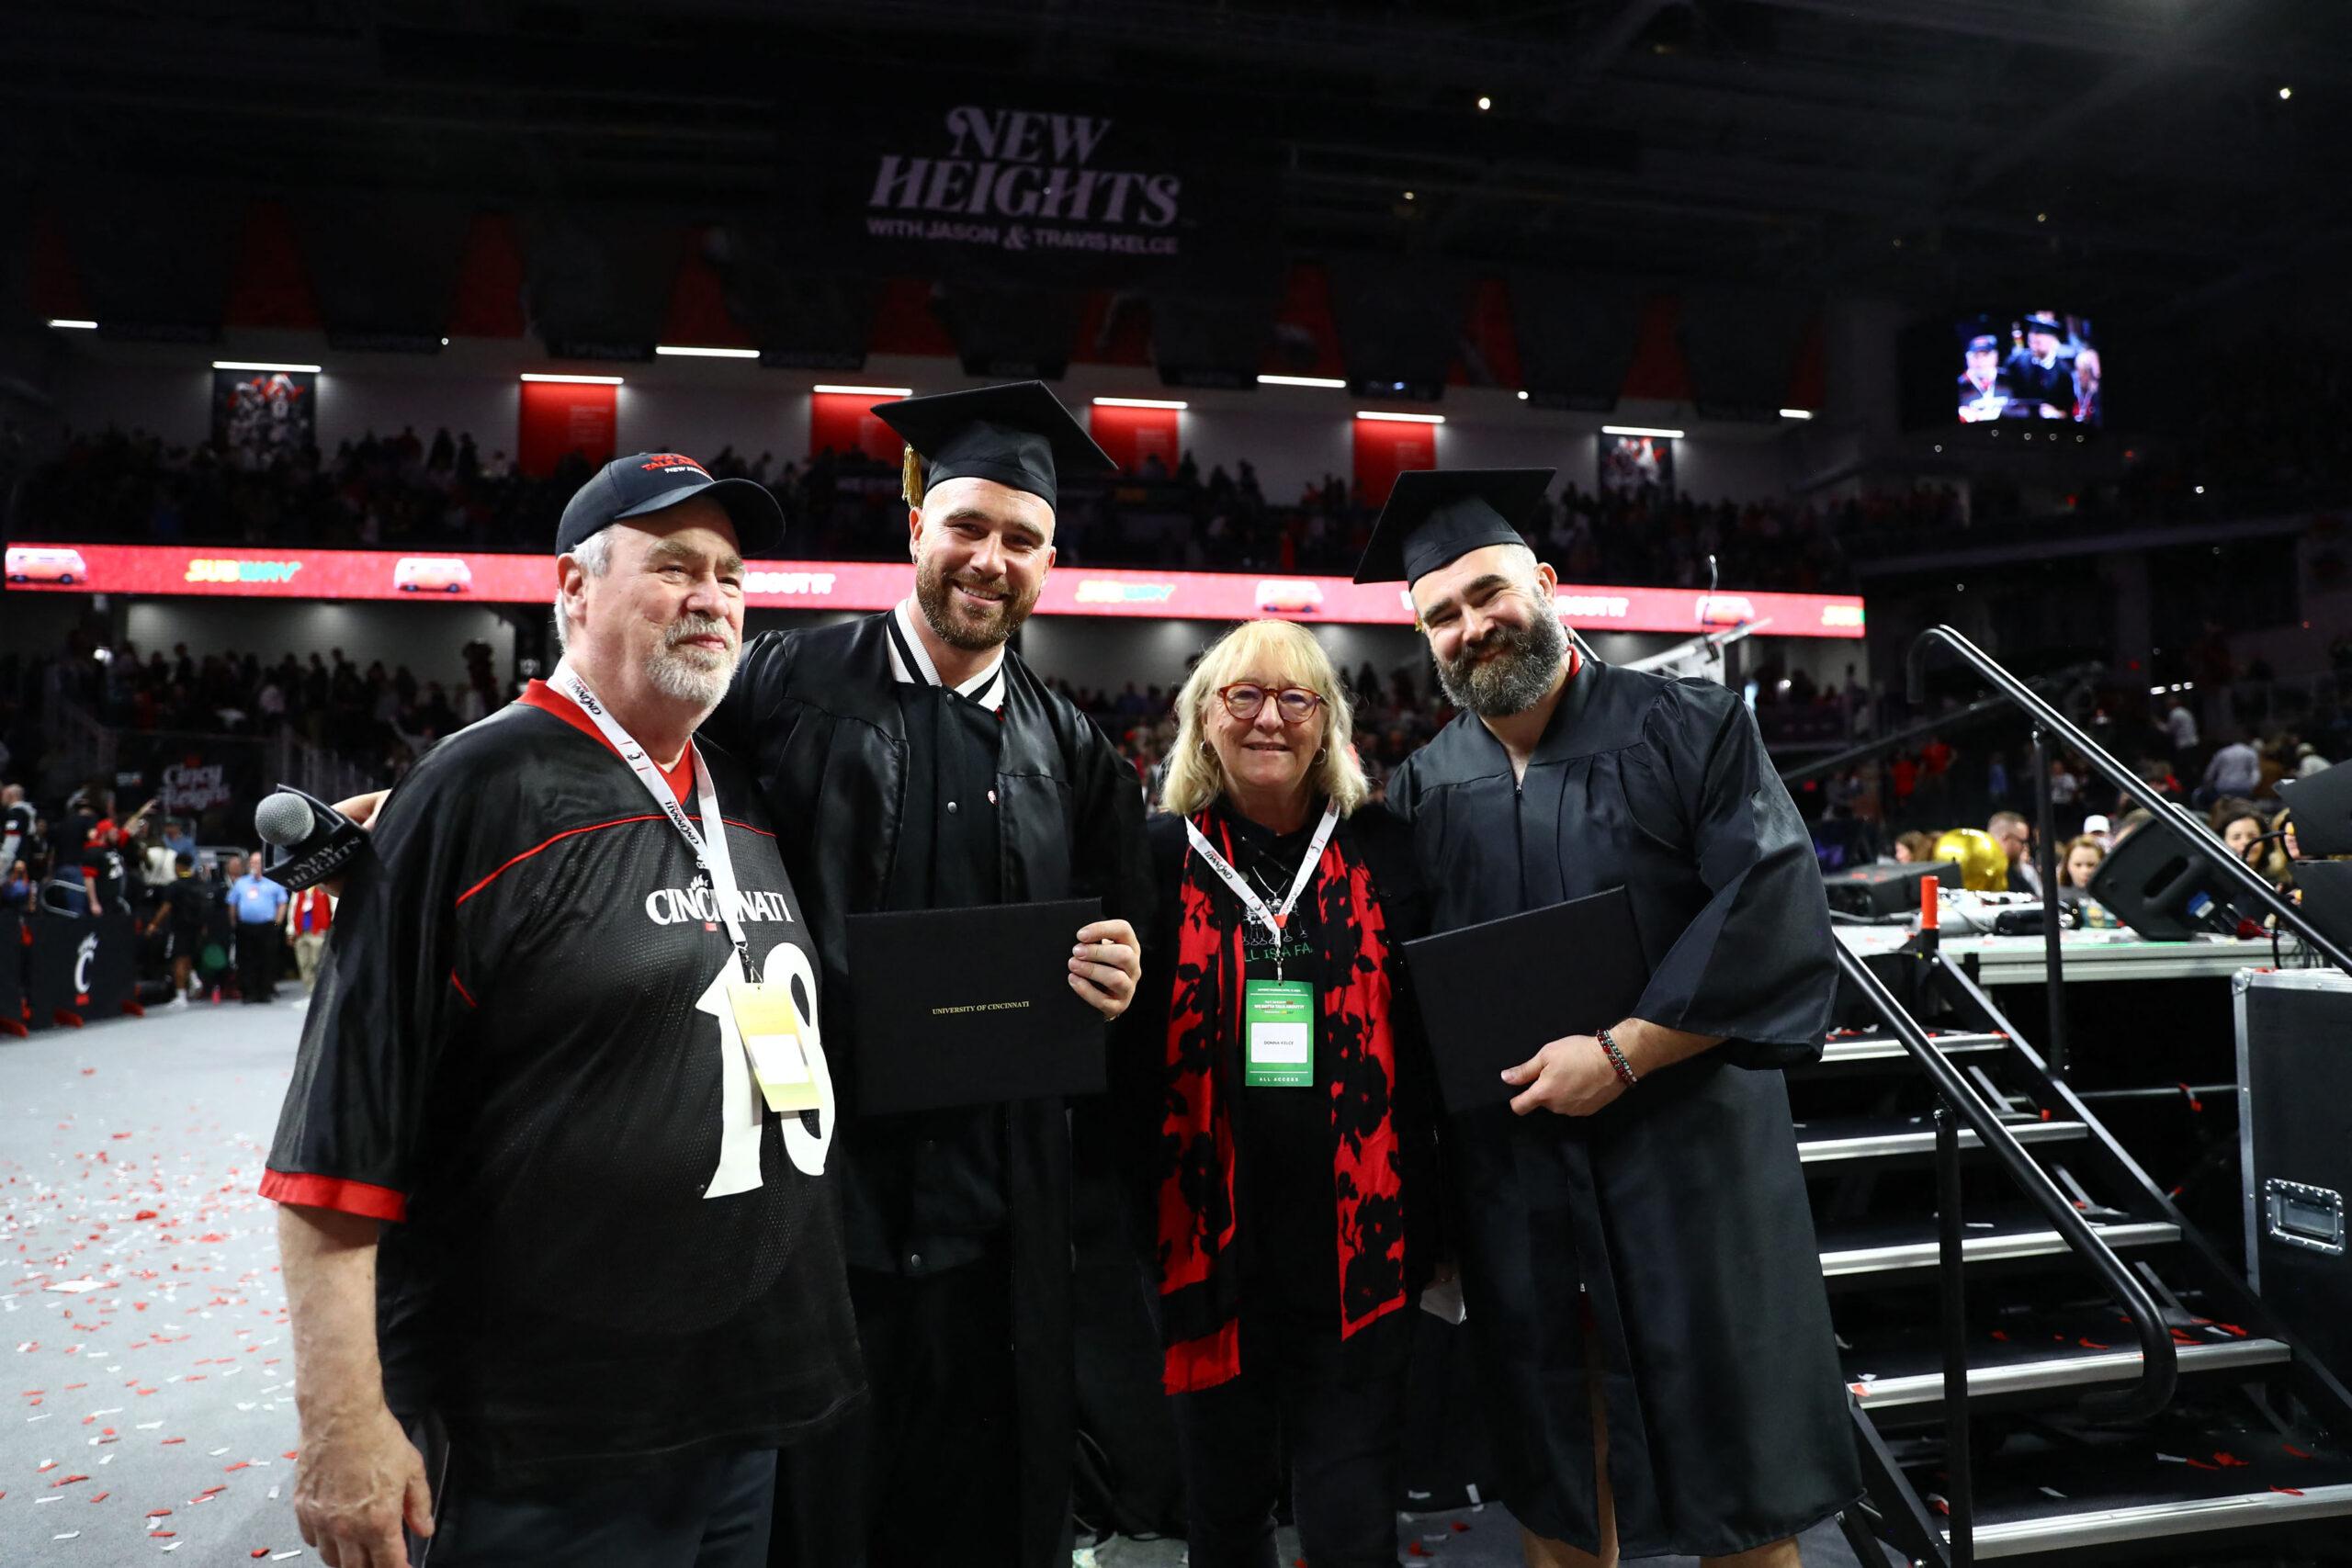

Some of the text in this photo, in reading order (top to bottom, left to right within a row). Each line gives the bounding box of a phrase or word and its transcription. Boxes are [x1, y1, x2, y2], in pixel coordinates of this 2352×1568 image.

[944, 105, 1114, 165] NEW
[867, 154, 1182, 228] HEIGHTS
[865, 217, 1180, 255] WITH JASON & TRAVIS KELCE
[664, 466, 686, 475] NEW
[185, 558, 303, 583] SUBWAY
[566, 676, 602, 716] CINCINNATI
[664, 800, 700, 845] CINCINNATI
[286, 835, 363, 886] HEIGHTS
[293, 842, 334, 873] NEW
[645, 885, 795, 926] CINCINATI
[1295, 941, 1314, 956] FA
[932, 1005, 976, 1015] UNIVERSITY
[988, 1000, 1030, 1011] CINCINNATI
